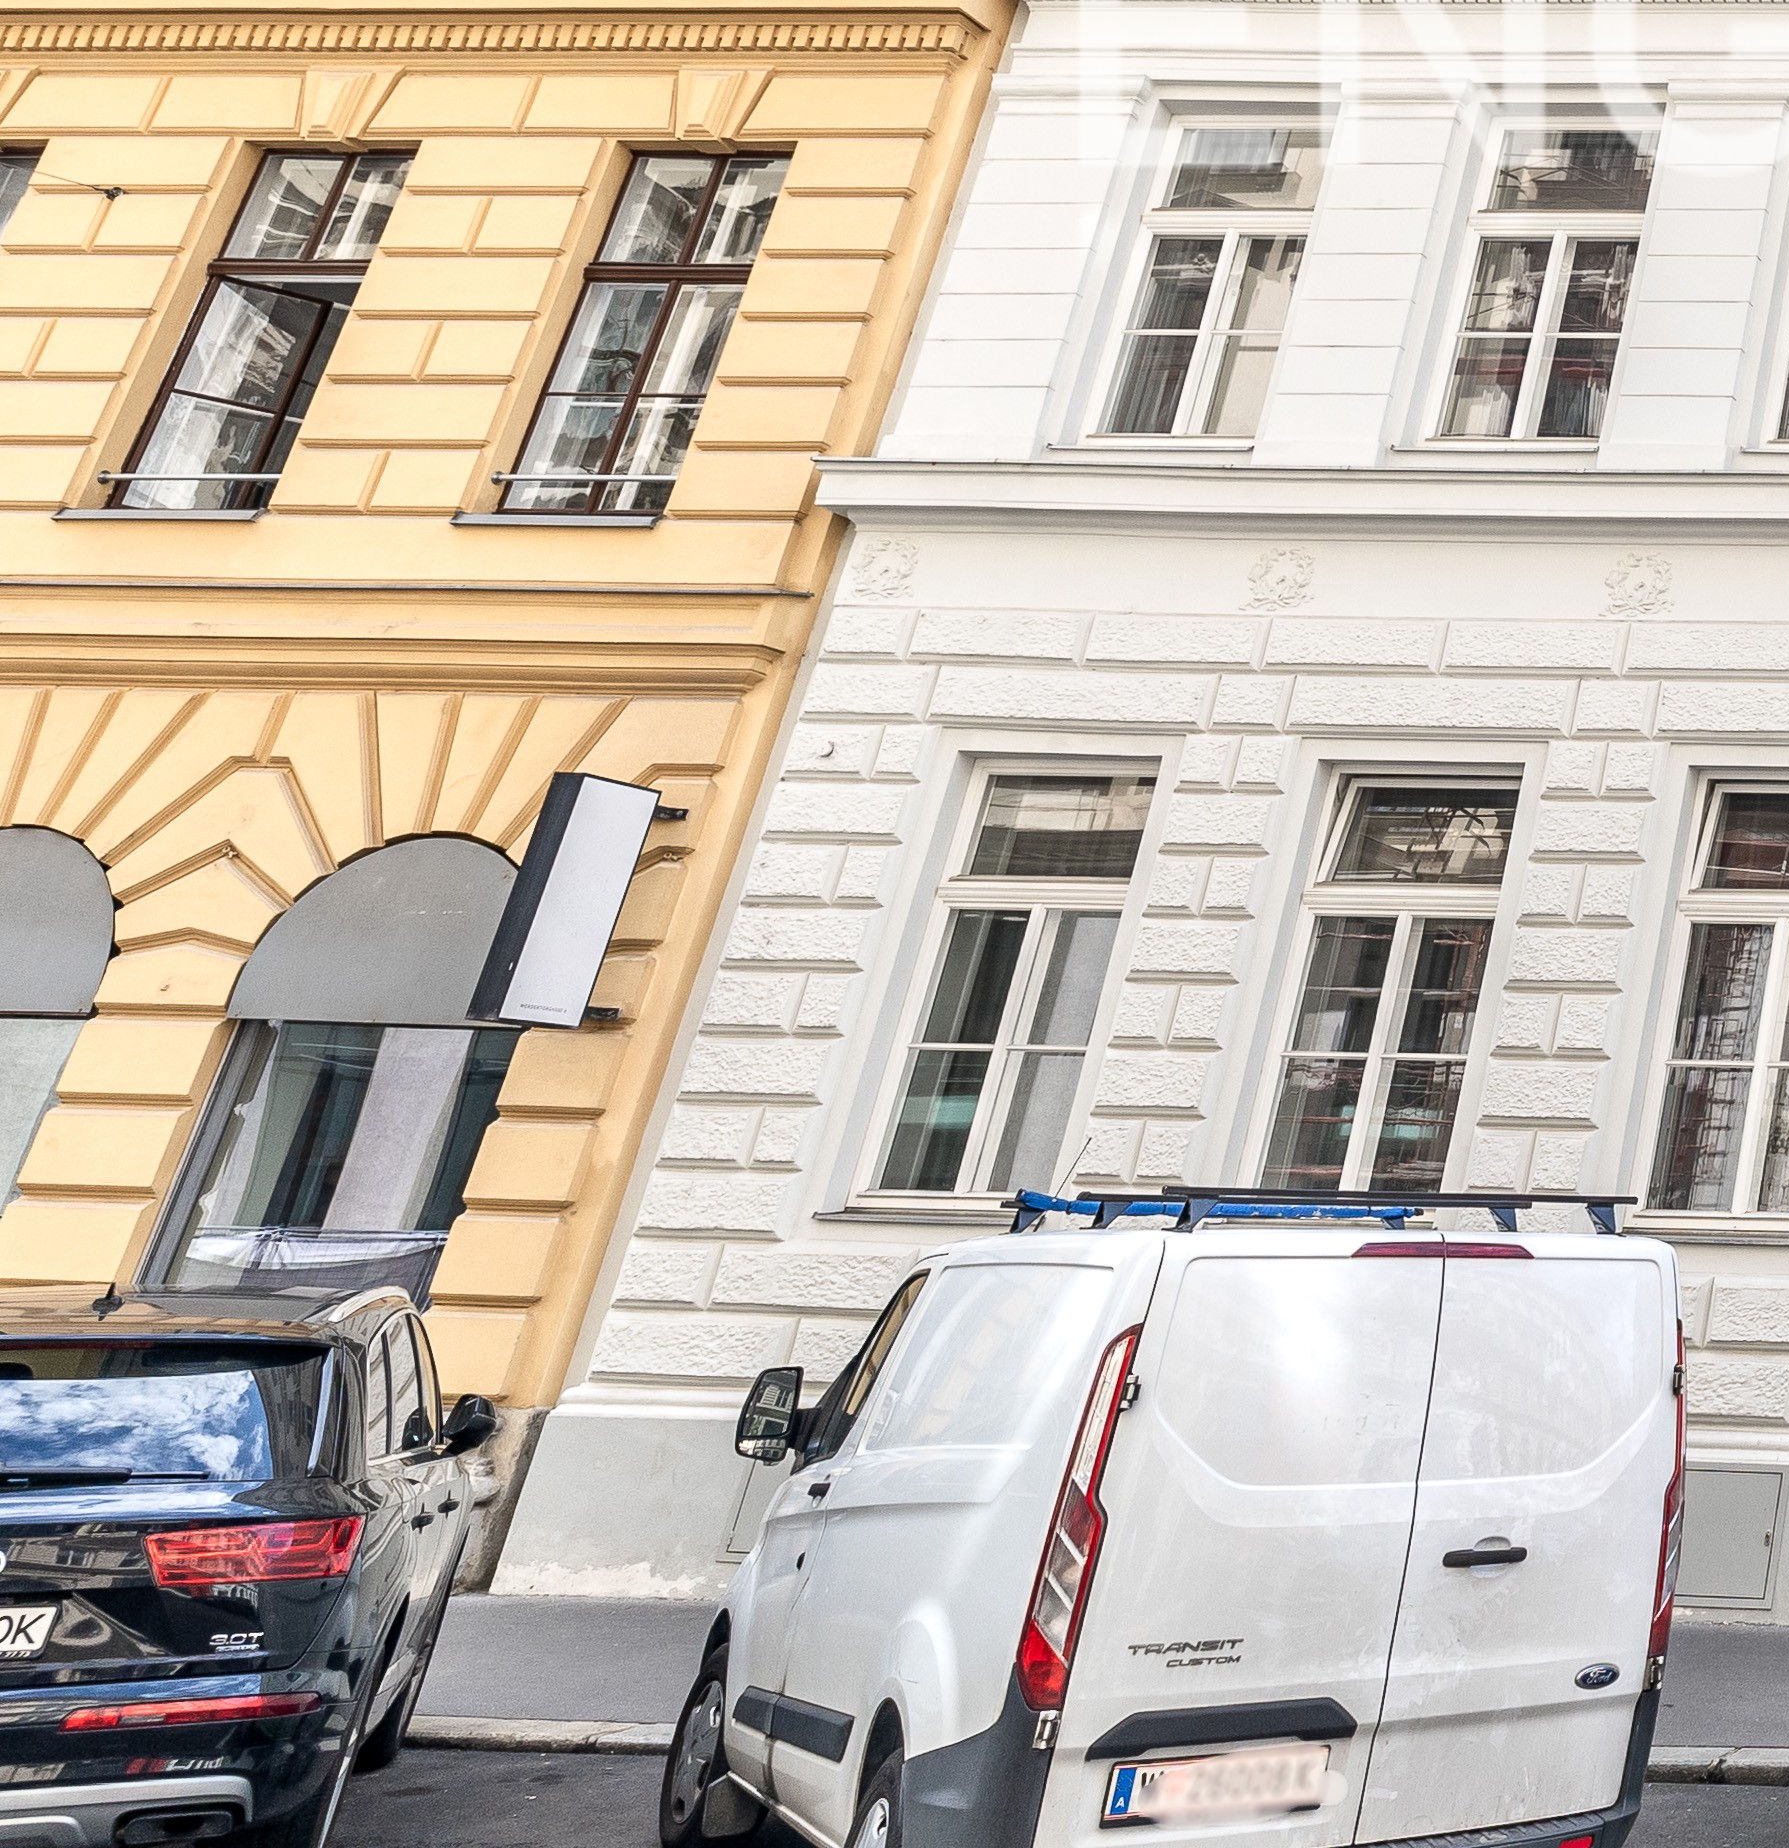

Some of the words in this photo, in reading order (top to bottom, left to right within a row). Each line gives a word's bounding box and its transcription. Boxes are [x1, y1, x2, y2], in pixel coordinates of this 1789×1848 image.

[209, 1632, 264, 1645] 3.0T
[1128, 1638, 1244, 1656] TRANSIT
[1166, 1655, 1242, 1668] CUSTOM
[1114, 1796, 1125, 1808] A
